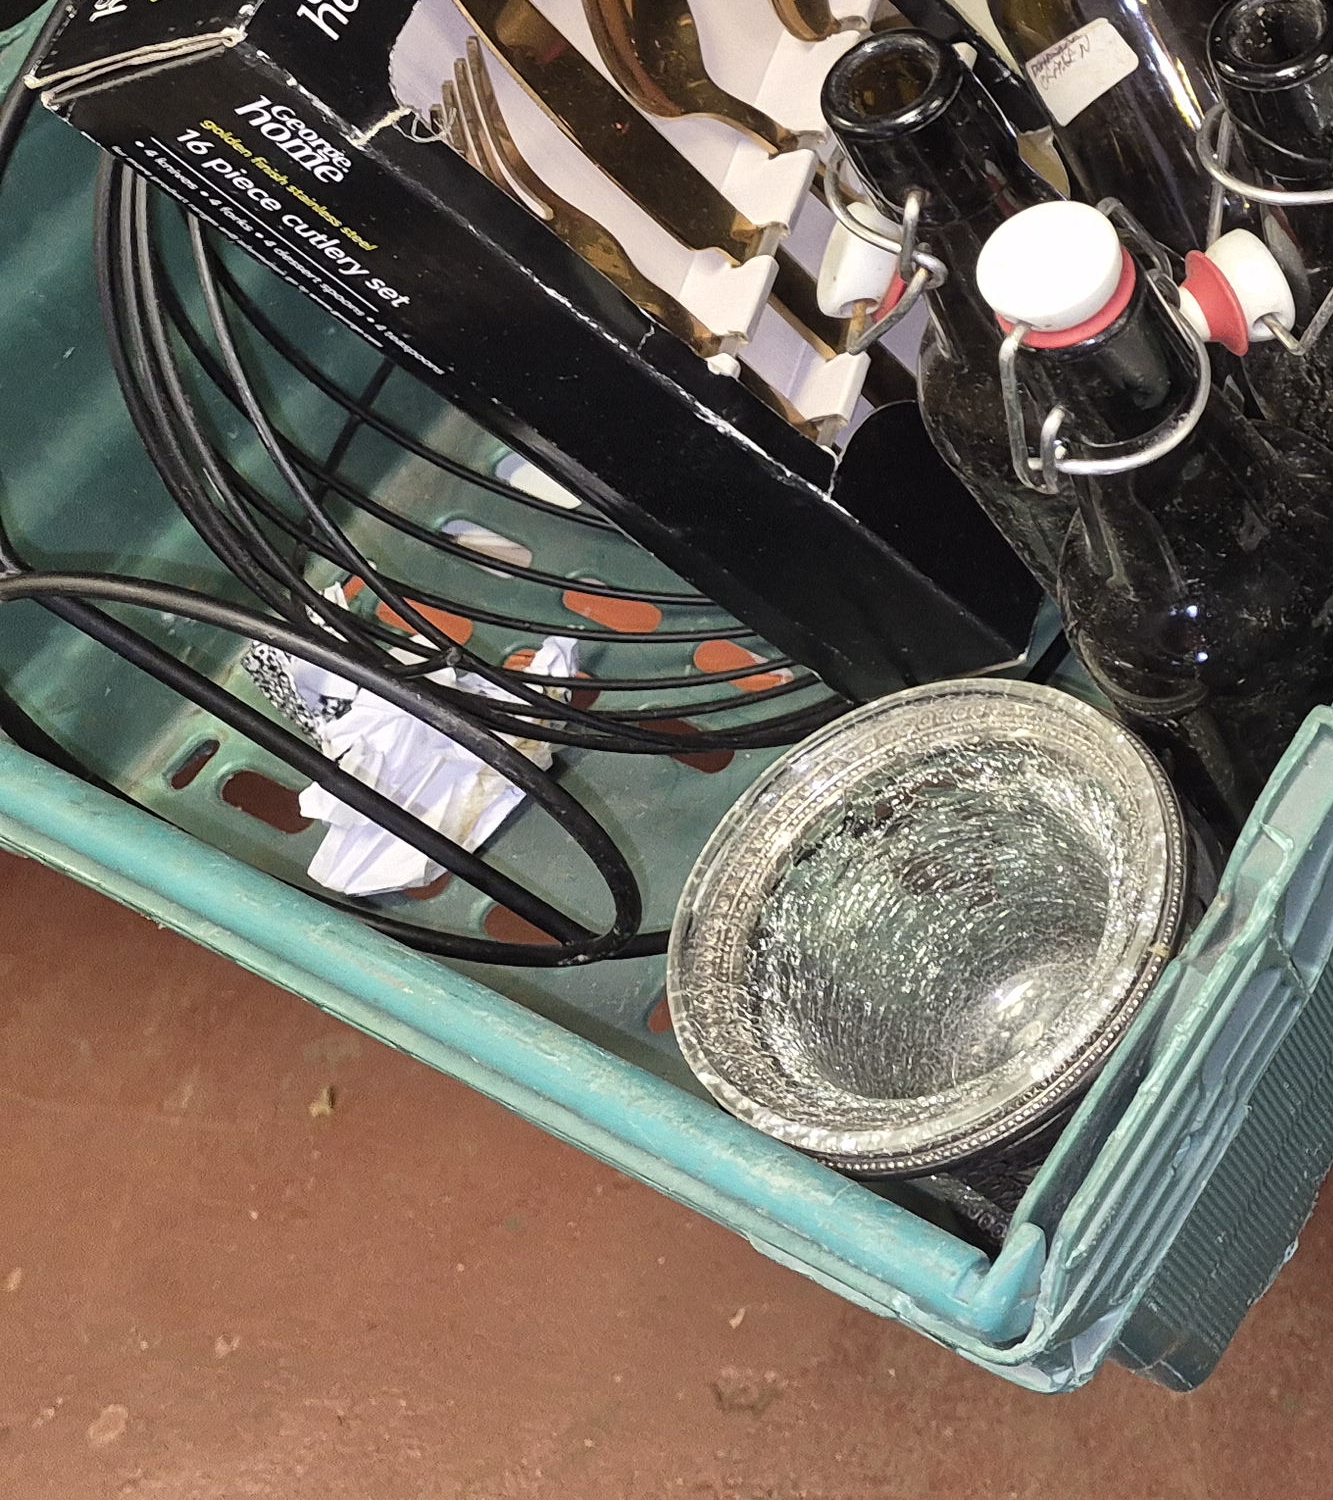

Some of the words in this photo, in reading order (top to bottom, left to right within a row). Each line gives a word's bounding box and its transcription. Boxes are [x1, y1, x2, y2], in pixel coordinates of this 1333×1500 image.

[199, 119, 253, 158] golden
[250, 156, 289, 186] finish
[285, 184, 343, 228] stainless
[339, 226, 379, 251] steel
[234, 94, 344, 183] home
[143, 149, 159, 158] 4
[154, 157, 199, 190] knives
[208, 198, 223, 206] 4
[219, 206, 254, 232] forks
[263, 239, 277, 247] 4
[273, 247, 323, 284] dessert
[319, 283, 366, 317] spoons
[383, 330, 445, 375] teaspoons
[176, 128, 215, 155] 16
[200, 157, 282, 212] piece
[279, 214, 370, 275] cutlery
[364, 278, 411, 308] set
